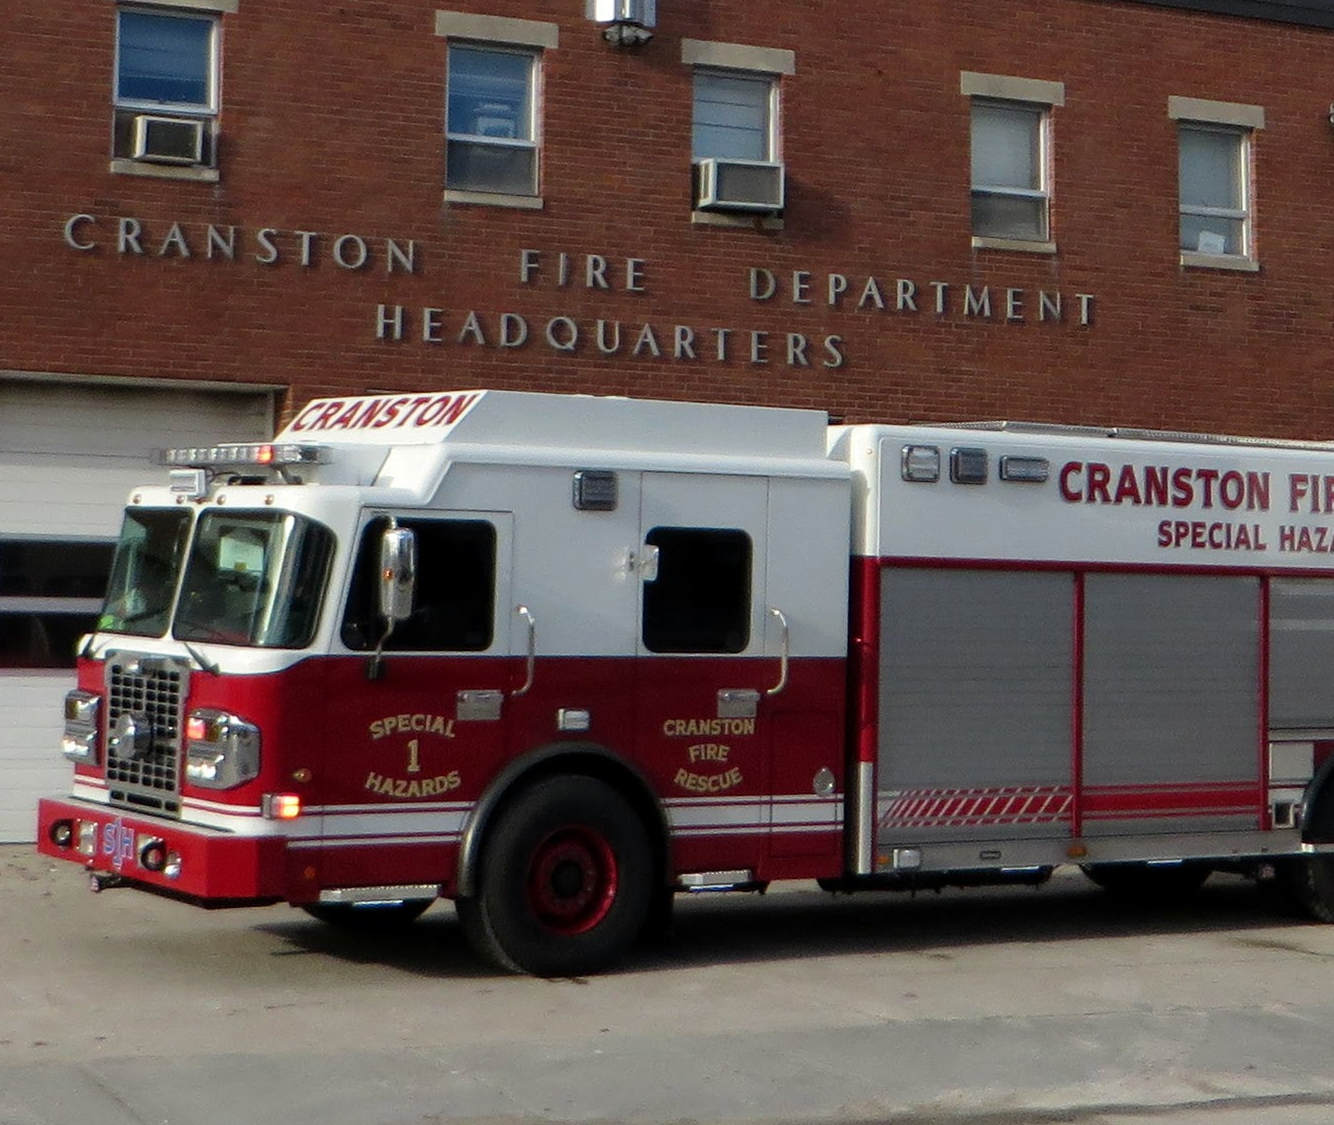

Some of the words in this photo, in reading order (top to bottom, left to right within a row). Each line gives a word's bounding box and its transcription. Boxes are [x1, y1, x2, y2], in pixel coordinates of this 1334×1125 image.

[65, 213, 419, 273] CRANSTON
[519, 249, 646, 292] FIRE
[749, 267, 1095, 326] DEPARTMENT
[374, 304, 846, 367] HEADQUARTERS
[291, 393, 478, 432] CRANSTON
[1059, 461, 1272, 513] CRANSTON
[1157, 519, 1267, 551] SPECIAL
[369, 714, 456, 739] SPECIAL
[663, 718, 755, 737] CRANSTON
[407, 740, 420, 772] 1
[688, 744, 730, 762] FIRE
[364, 771, 462, 798] HAZARDS
[673, 768, 743, 793] RESCUE
